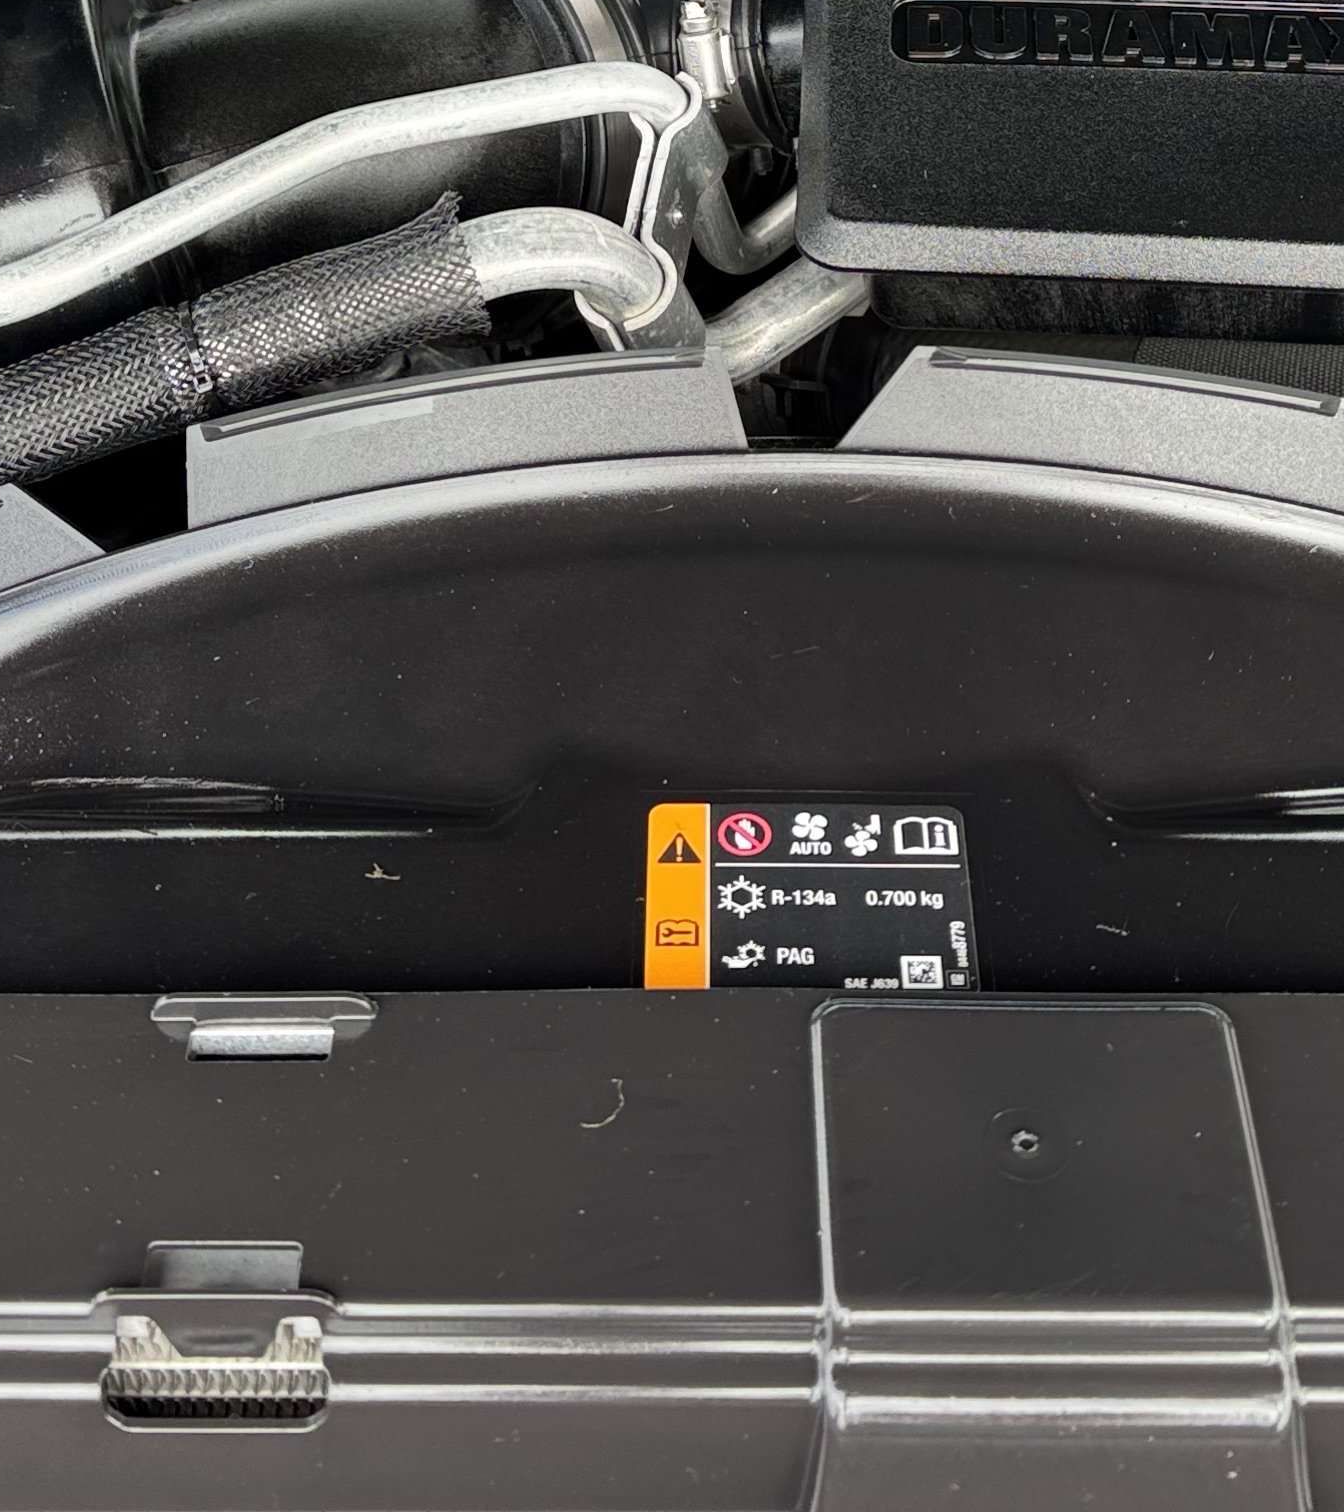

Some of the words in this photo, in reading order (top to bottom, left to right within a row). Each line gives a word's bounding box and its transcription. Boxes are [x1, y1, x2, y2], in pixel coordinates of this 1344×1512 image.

[789, 842, 832, 856] AUTO
[771, 890, 837, 906] R-134a
[865, 890, 917, 907] 0.700
[921, 890, 944, 909] kg
[776, 947, 815, 965] PAG
[844, 977, 869, 989] SAE
